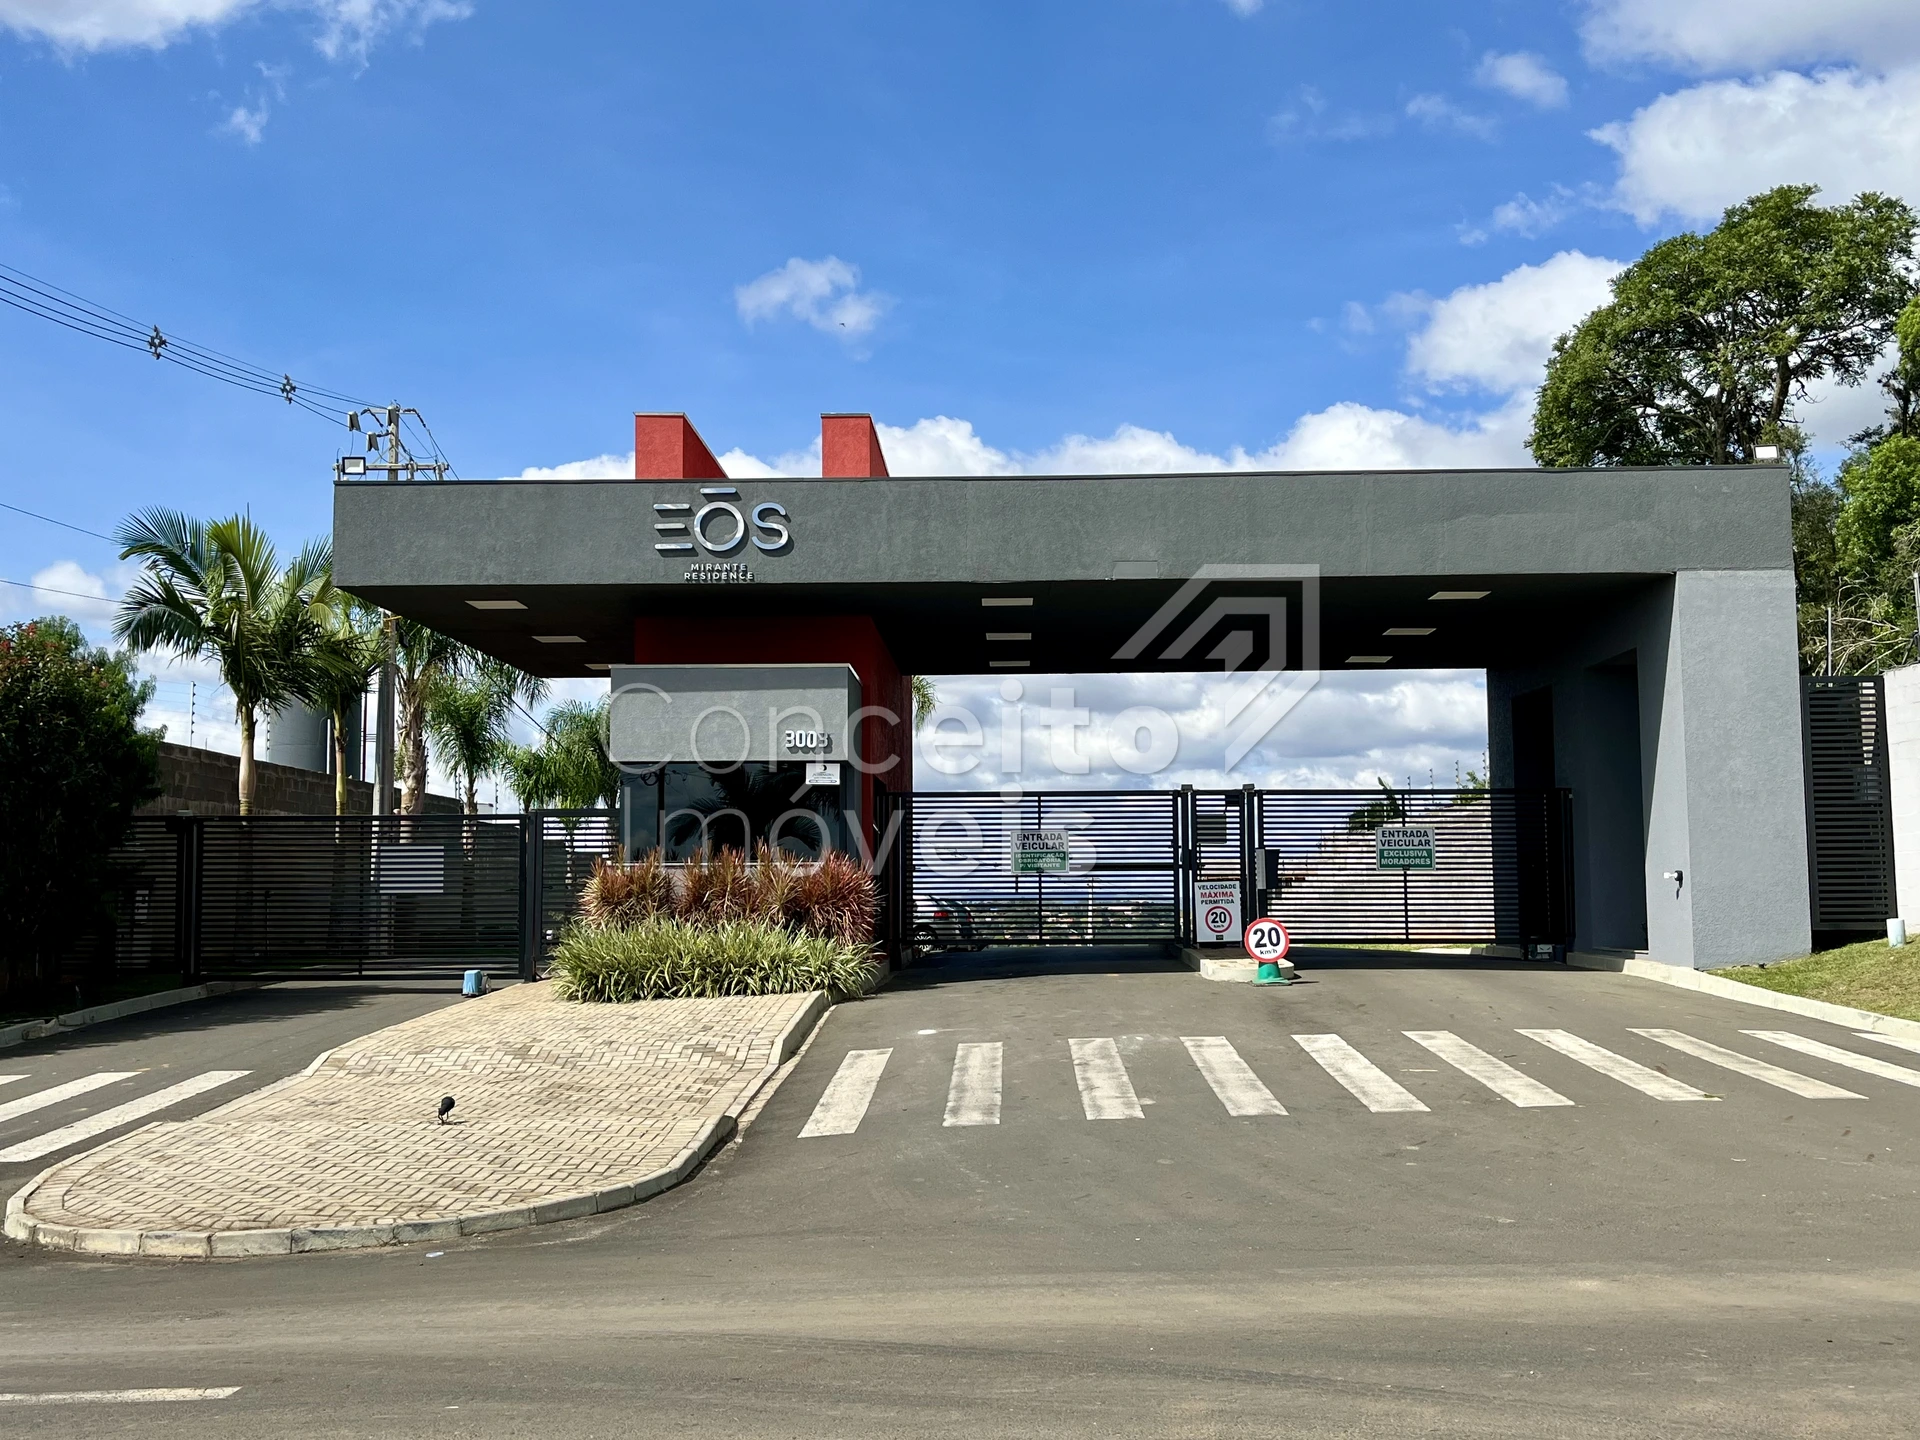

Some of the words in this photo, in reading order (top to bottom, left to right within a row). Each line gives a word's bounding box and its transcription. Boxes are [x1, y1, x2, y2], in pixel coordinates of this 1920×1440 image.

[690, 563, 747, 571] MIRANTE
[684, 572, 754, 580] RESIDENCE
[1016, 833, 1063, 841] ENTRADA
[1381, 830, 1429, 838] ENTRADA
[1015, 842, 1065, 850] VEICULAR
[1380, 839, 1431, 847] VEICULAR
[1210, 911, 1227, 924] 20
[1252, 927, 1281, 948] 20
